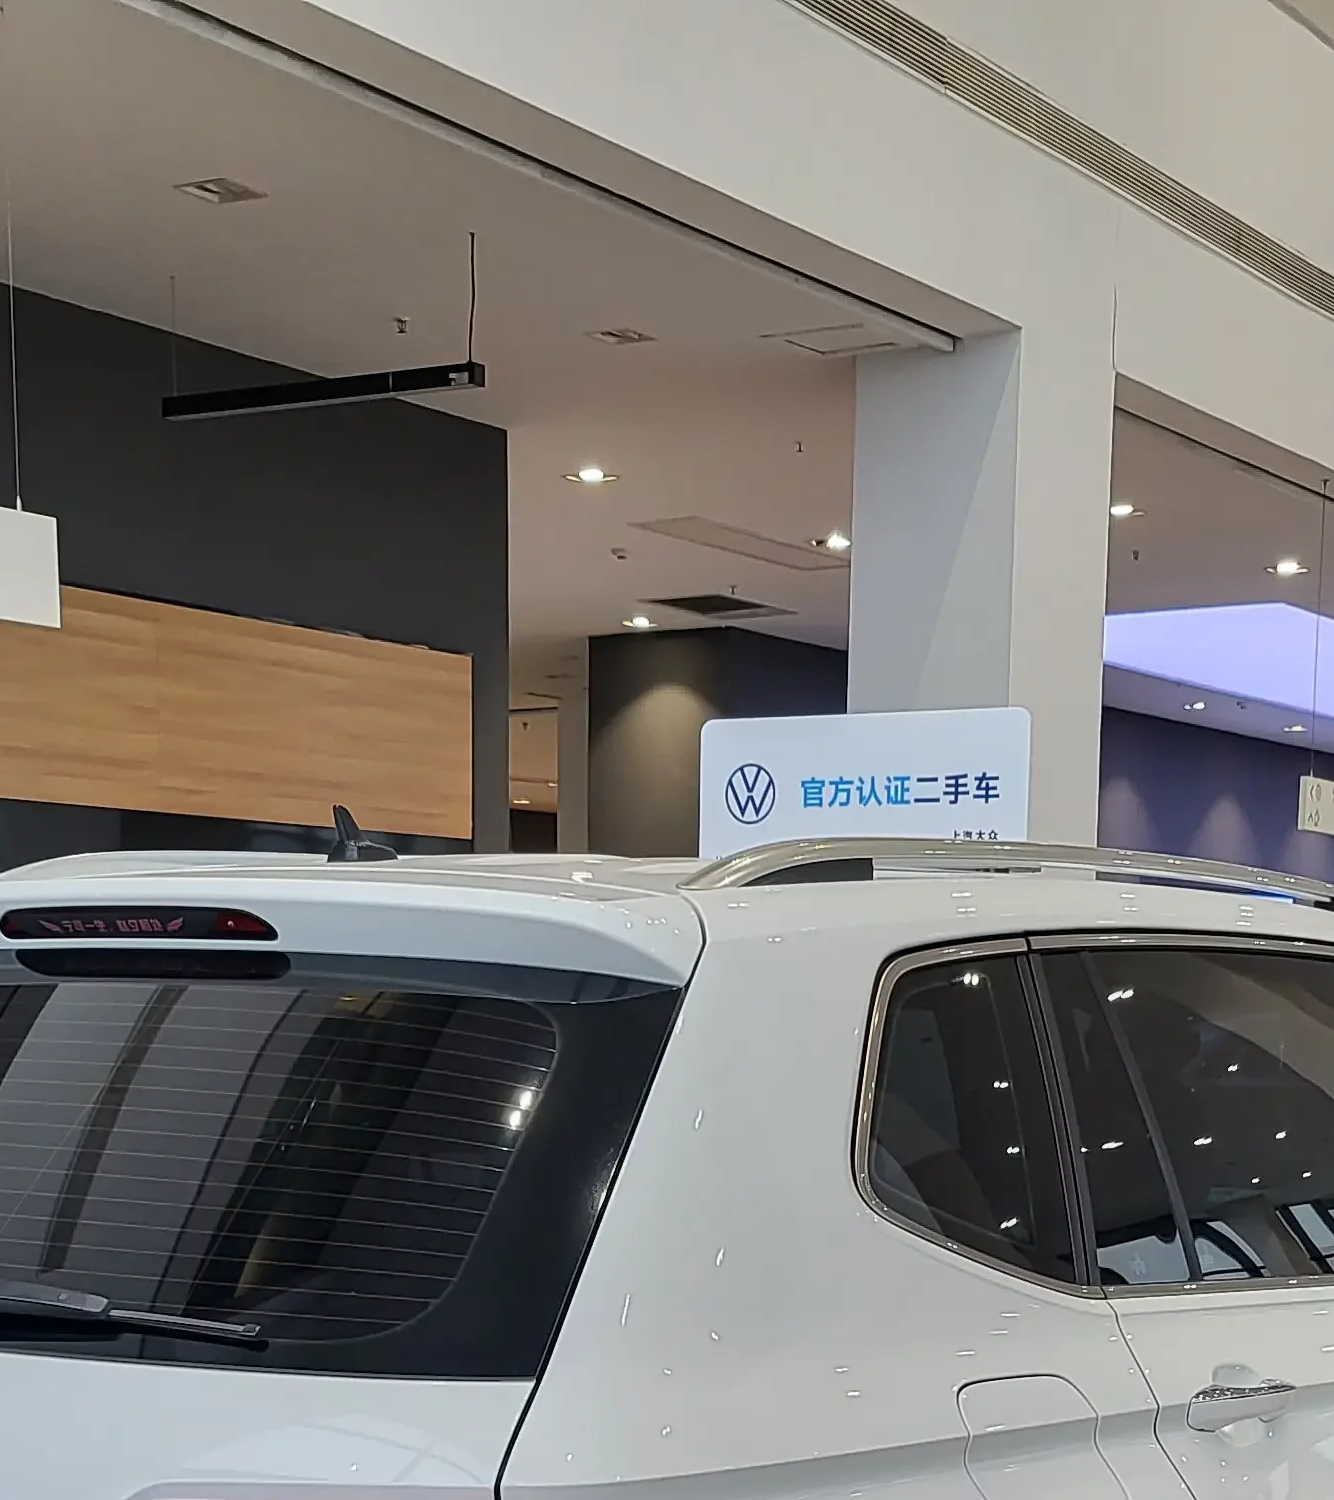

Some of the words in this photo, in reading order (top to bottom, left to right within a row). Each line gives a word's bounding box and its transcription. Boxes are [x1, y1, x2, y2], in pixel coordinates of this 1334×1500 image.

[800, 771, 1001, 808] 官方认证二手车
